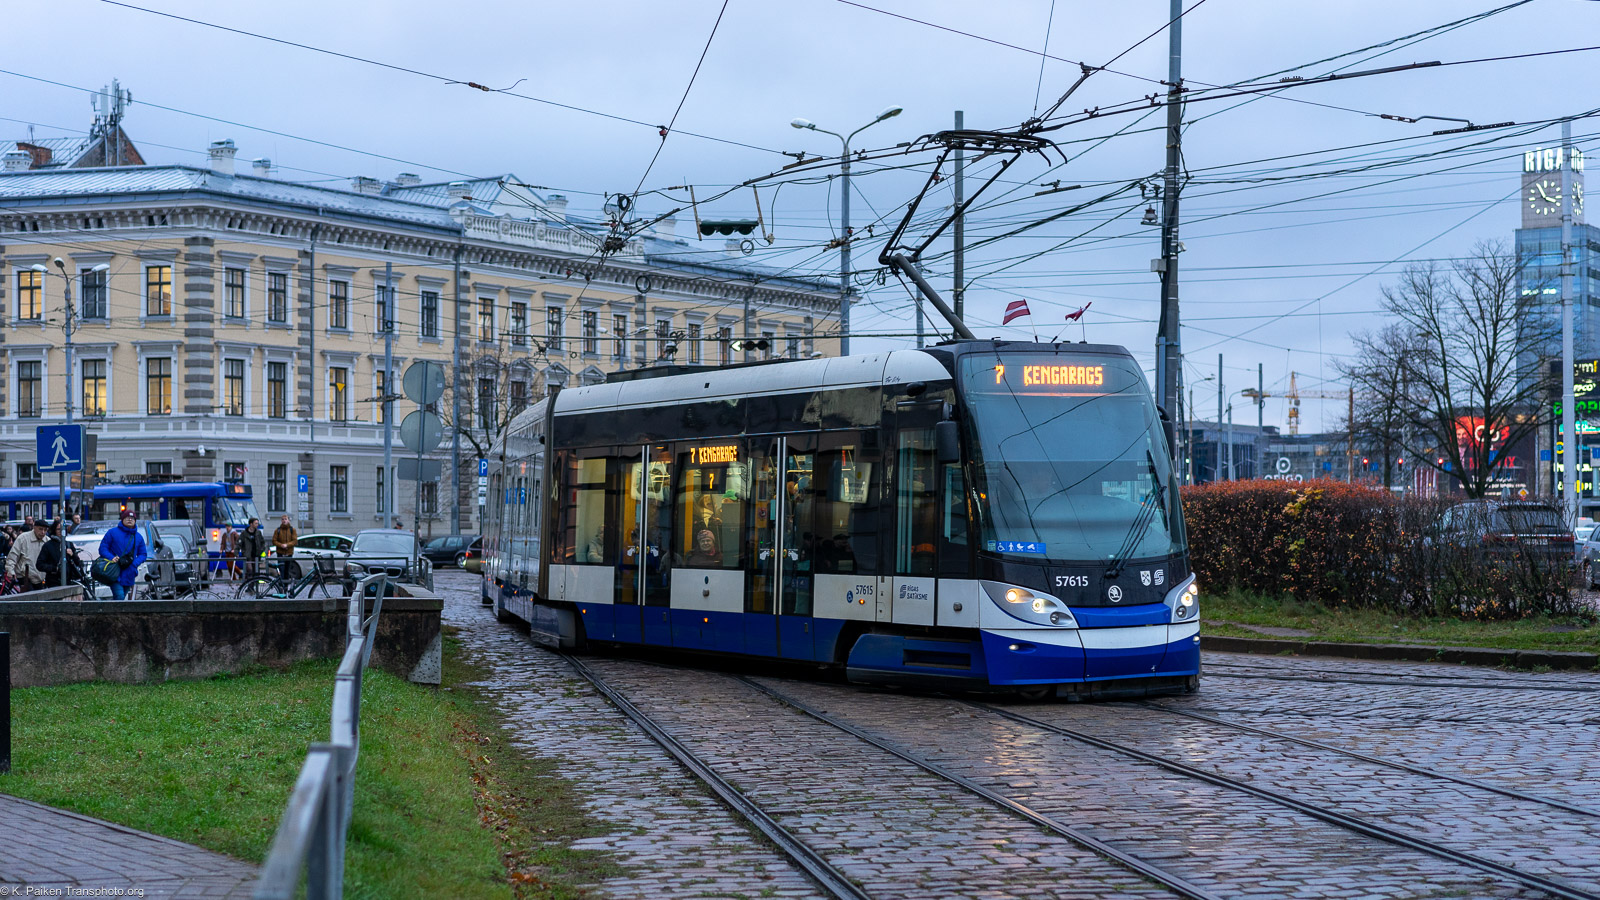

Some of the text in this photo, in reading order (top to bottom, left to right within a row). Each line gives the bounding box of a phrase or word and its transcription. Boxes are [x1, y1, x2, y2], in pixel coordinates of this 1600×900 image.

[995, 365, 1004, 384] 7
[690, 448, 696, 463] 7
[481, 461, 488, 474] P
[300, 476, 306, 490] P
[710, 473, 714, 489] 7
[1056, 576, 1088, 586] 57615
[856, 584, 873, 595] 57615
